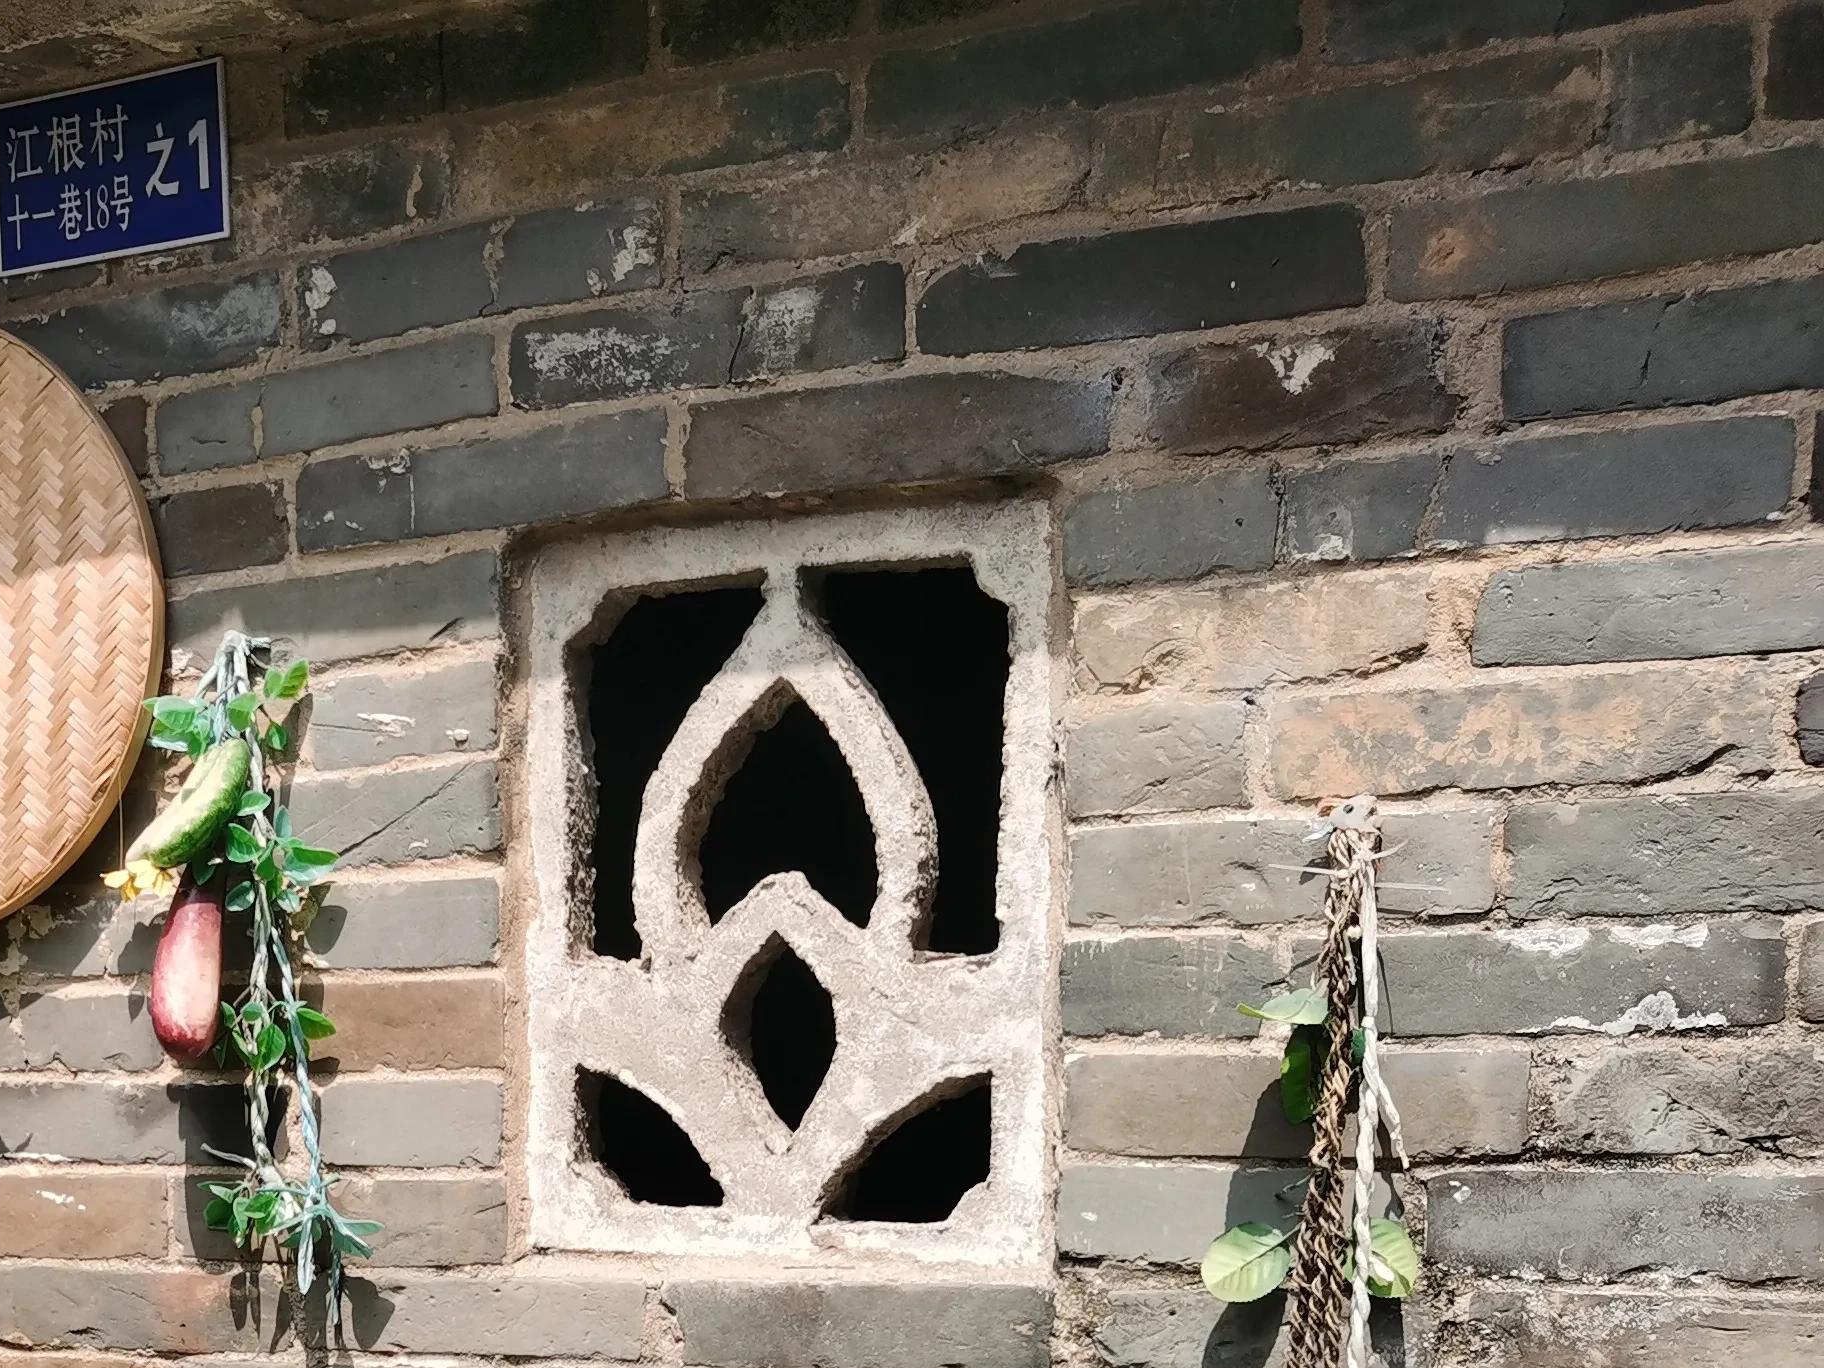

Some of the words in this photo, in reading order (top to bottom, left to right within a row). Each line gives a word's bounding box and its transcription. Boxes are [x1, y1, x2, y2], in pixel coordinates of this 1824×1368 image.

[5, 104, 129, 183] 江根村
[145, 118, 210, 198] 之1
[7, 174, 134, 251] 十一巷18号
